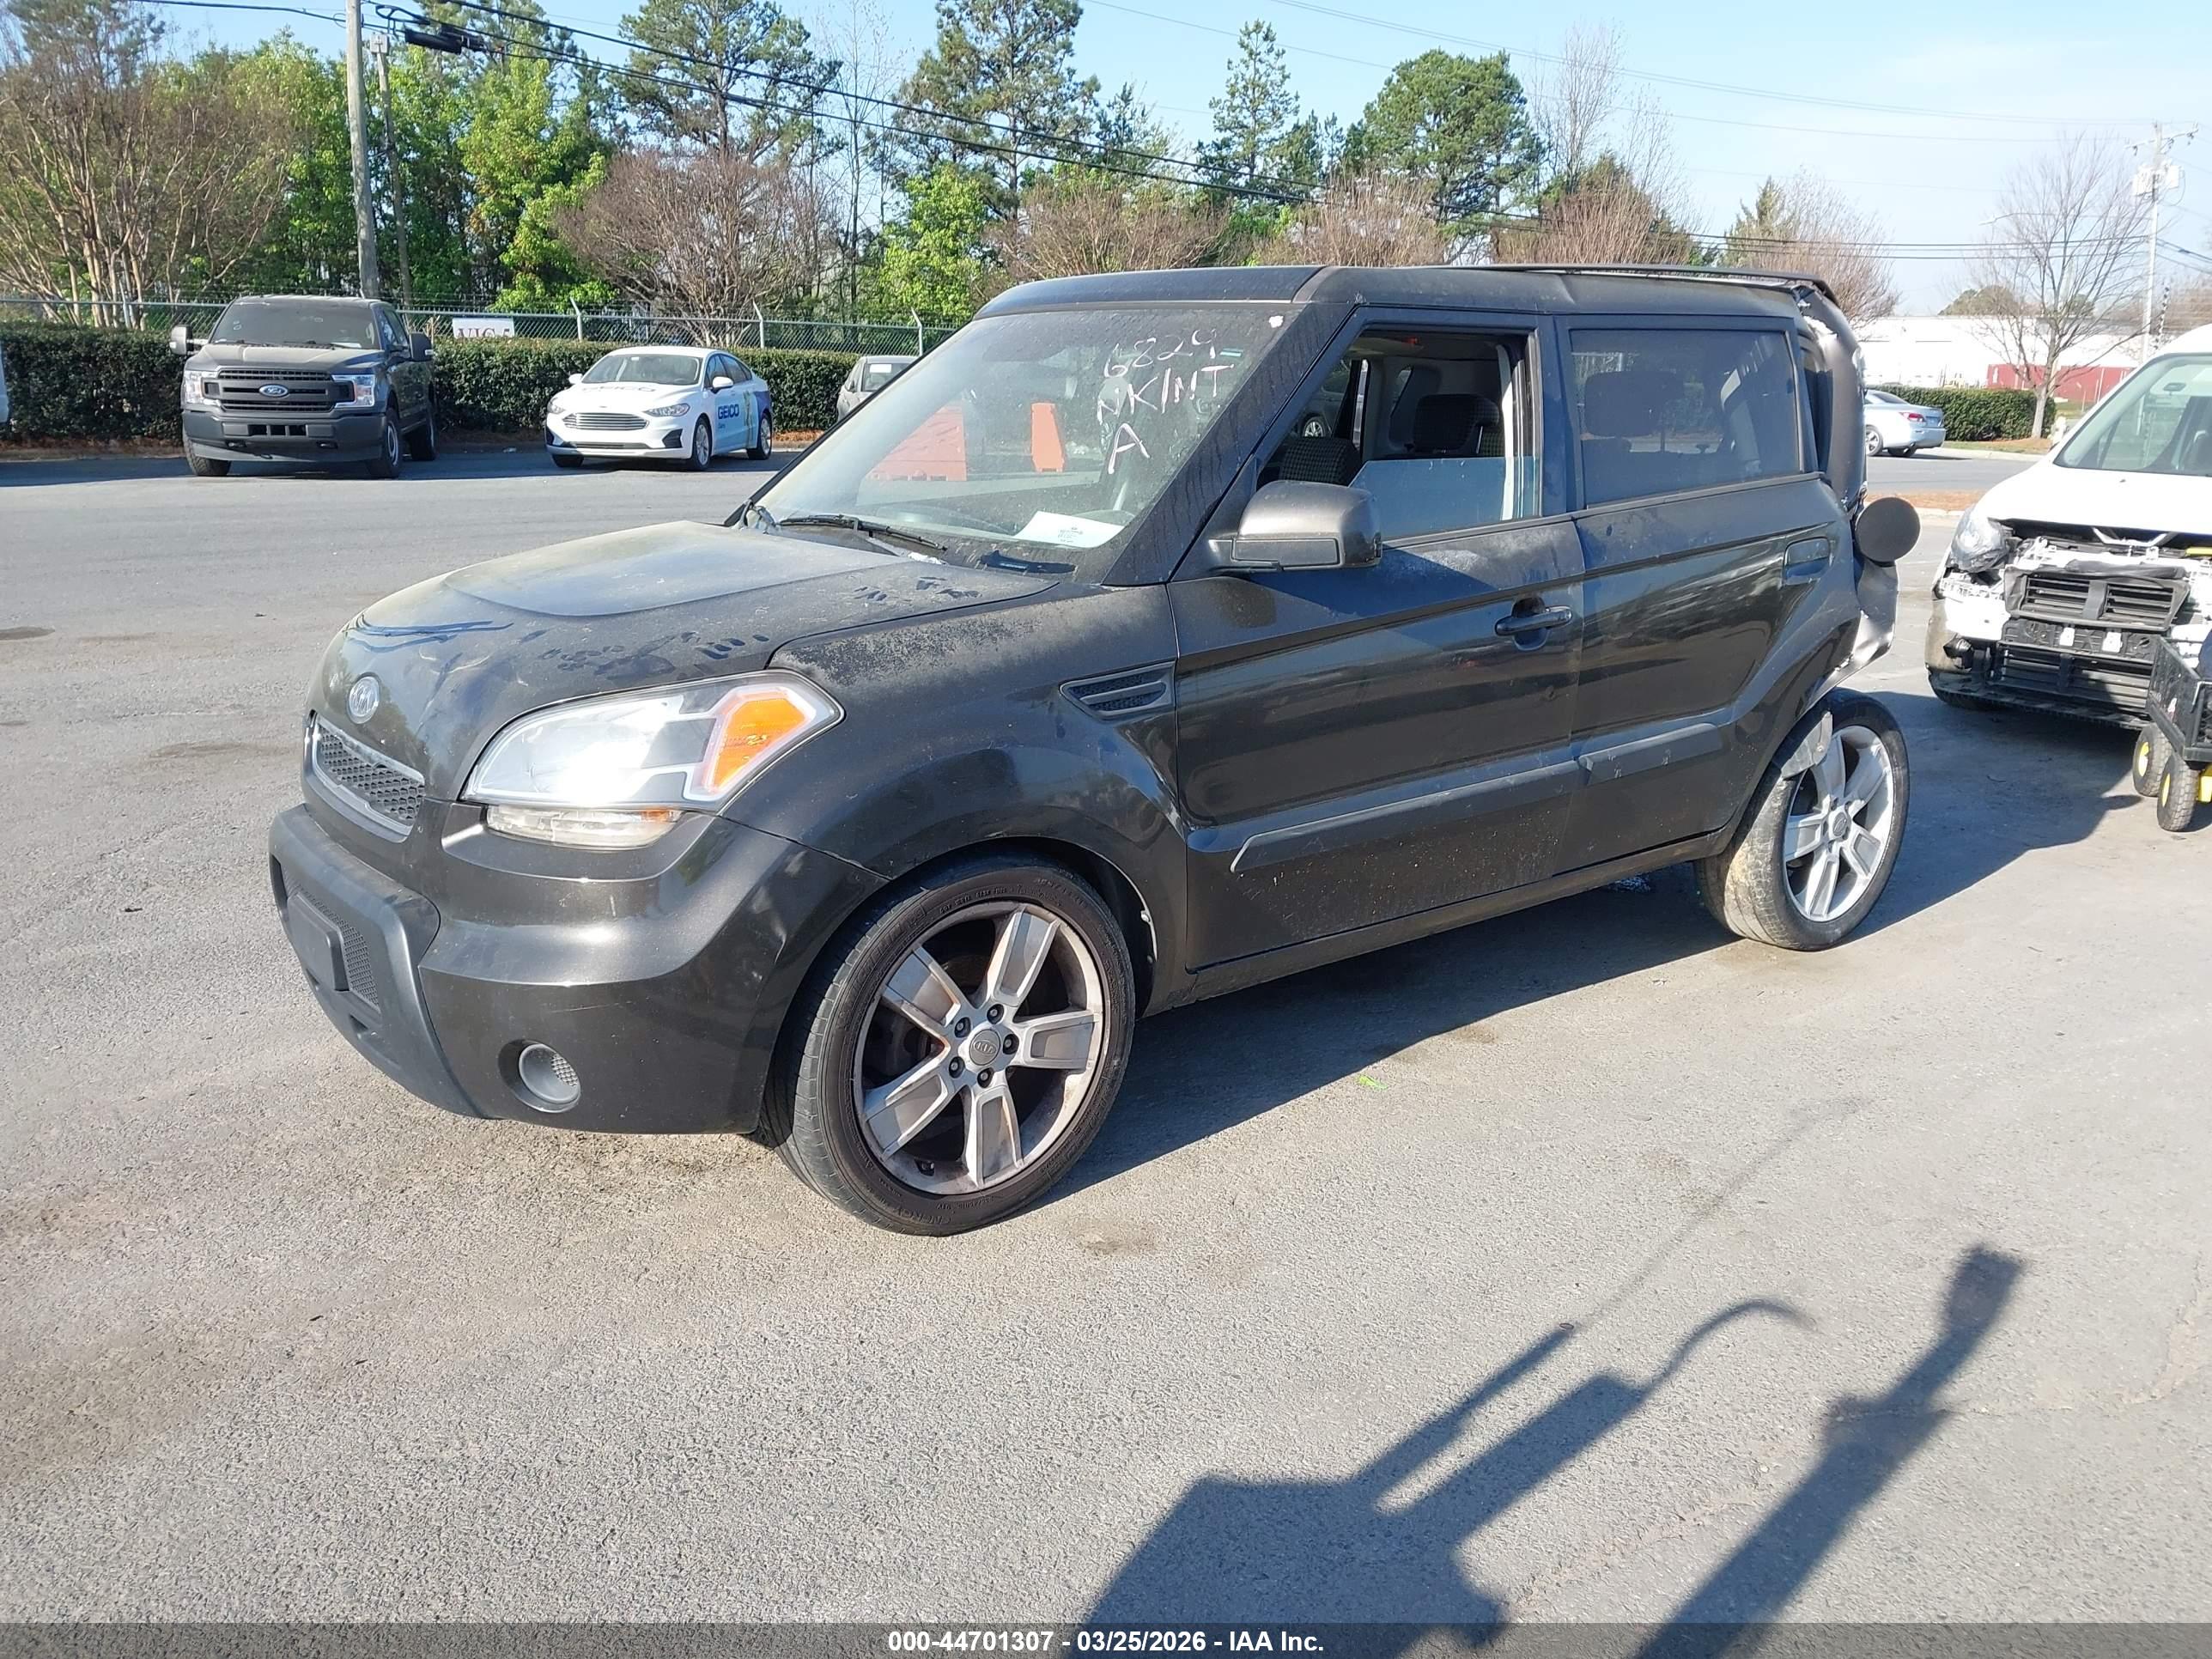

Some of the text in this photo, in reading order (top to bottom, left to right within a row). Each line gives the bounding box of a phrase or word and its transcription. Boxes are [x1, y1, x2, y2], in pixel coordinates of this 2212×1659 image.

[1103, 328, 1217, 378] 6829
[718, 404, 739, 419] GEICO
[1108, 423, 1150, 474] A
